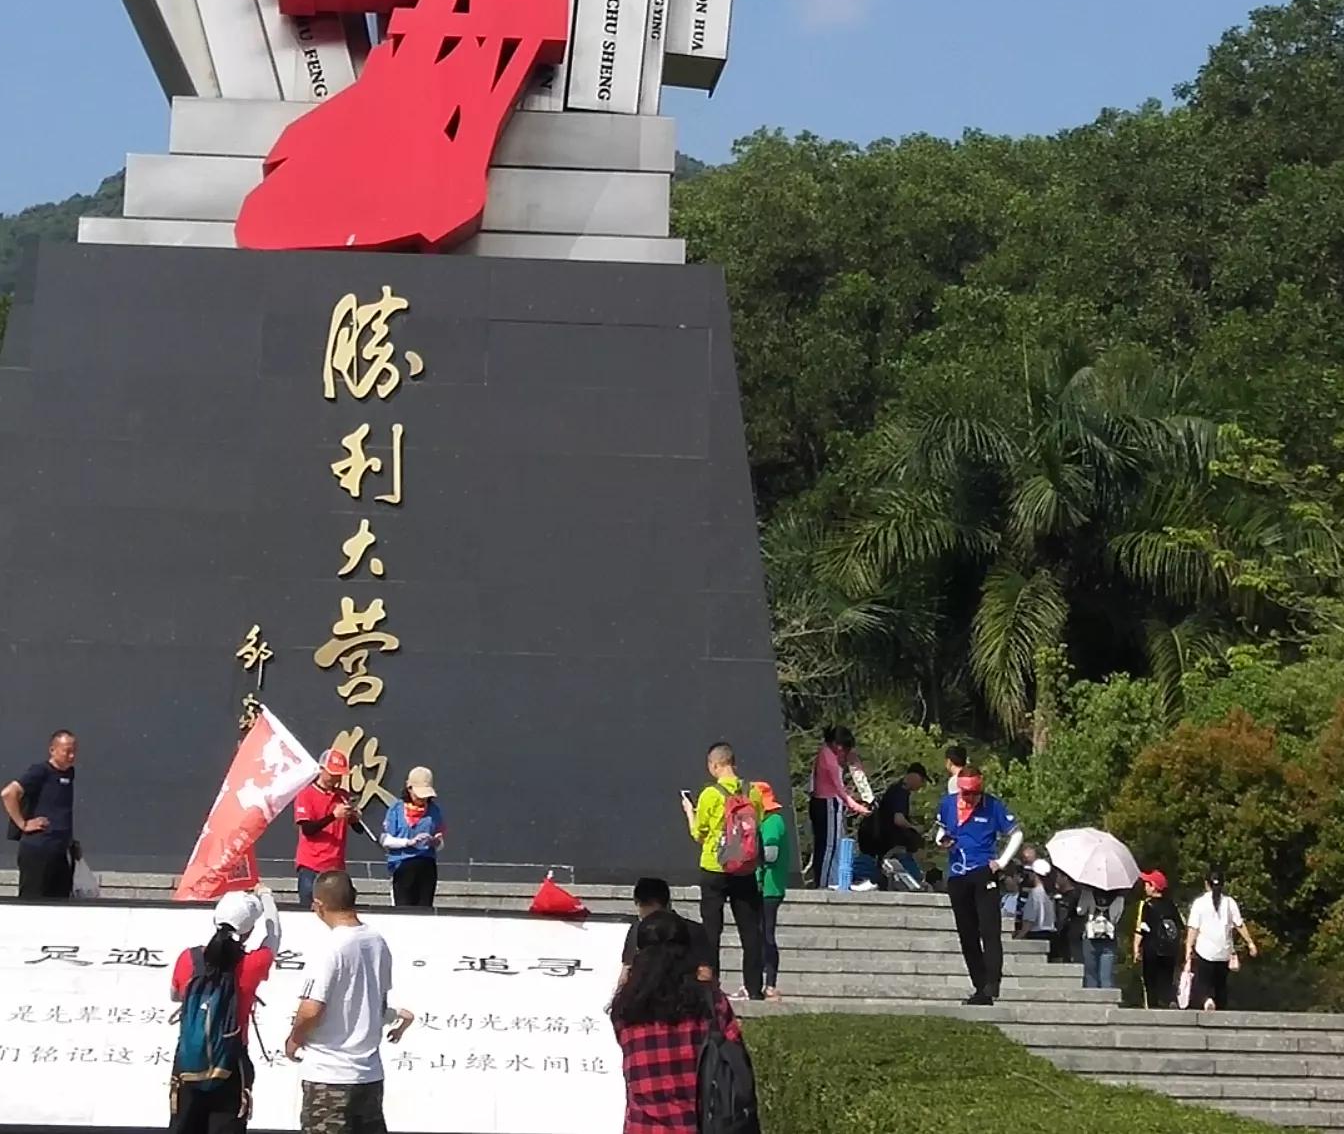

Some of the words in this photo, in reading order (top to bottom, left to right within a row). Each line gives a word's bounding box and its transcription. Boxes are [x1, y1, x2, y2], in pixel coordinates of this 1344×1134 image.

[651, 9, 664, 40] YING
[691, 19, 706, 51] HUA
[304, 48, 328, 97] FENG
[597, 40, 616, 101] SHENG
[453, 954, 594, 978] 追寻
